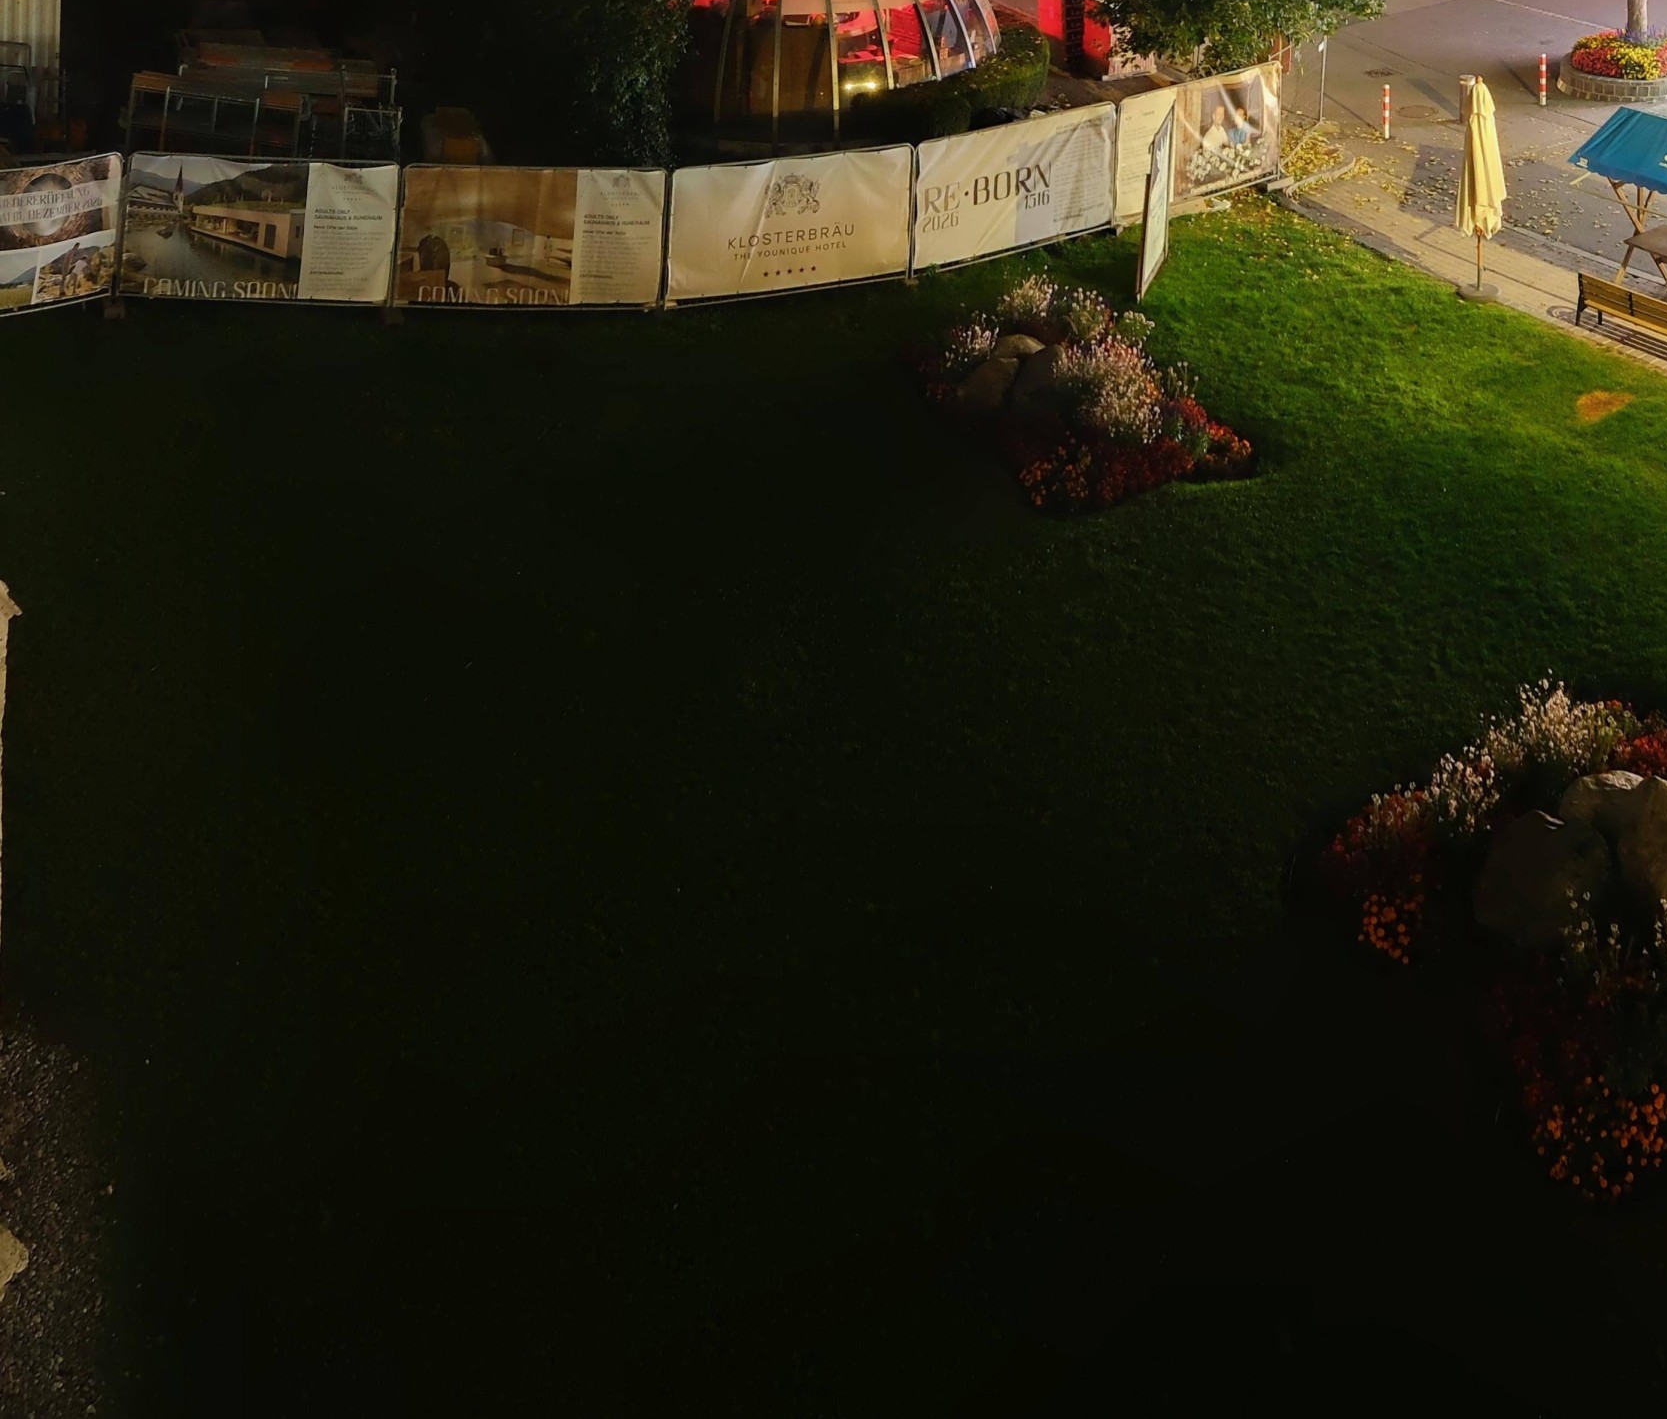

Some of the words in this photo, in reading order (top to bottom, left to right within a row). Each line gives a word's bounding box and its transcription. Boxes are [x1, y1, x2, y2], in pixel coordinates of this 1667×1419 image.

[1023, 189, 1051, 211] 1516
[922, 211, 960, 234] 2026
[727, 223, 856, 251] KLOSTERBRÄU
[733, 251, 753, 261] THE
[757, 246, 813, 259] YOUNIQUE
[815, 241, 848, 252] HOTEL
[142, 278, 226, 298] COMING
